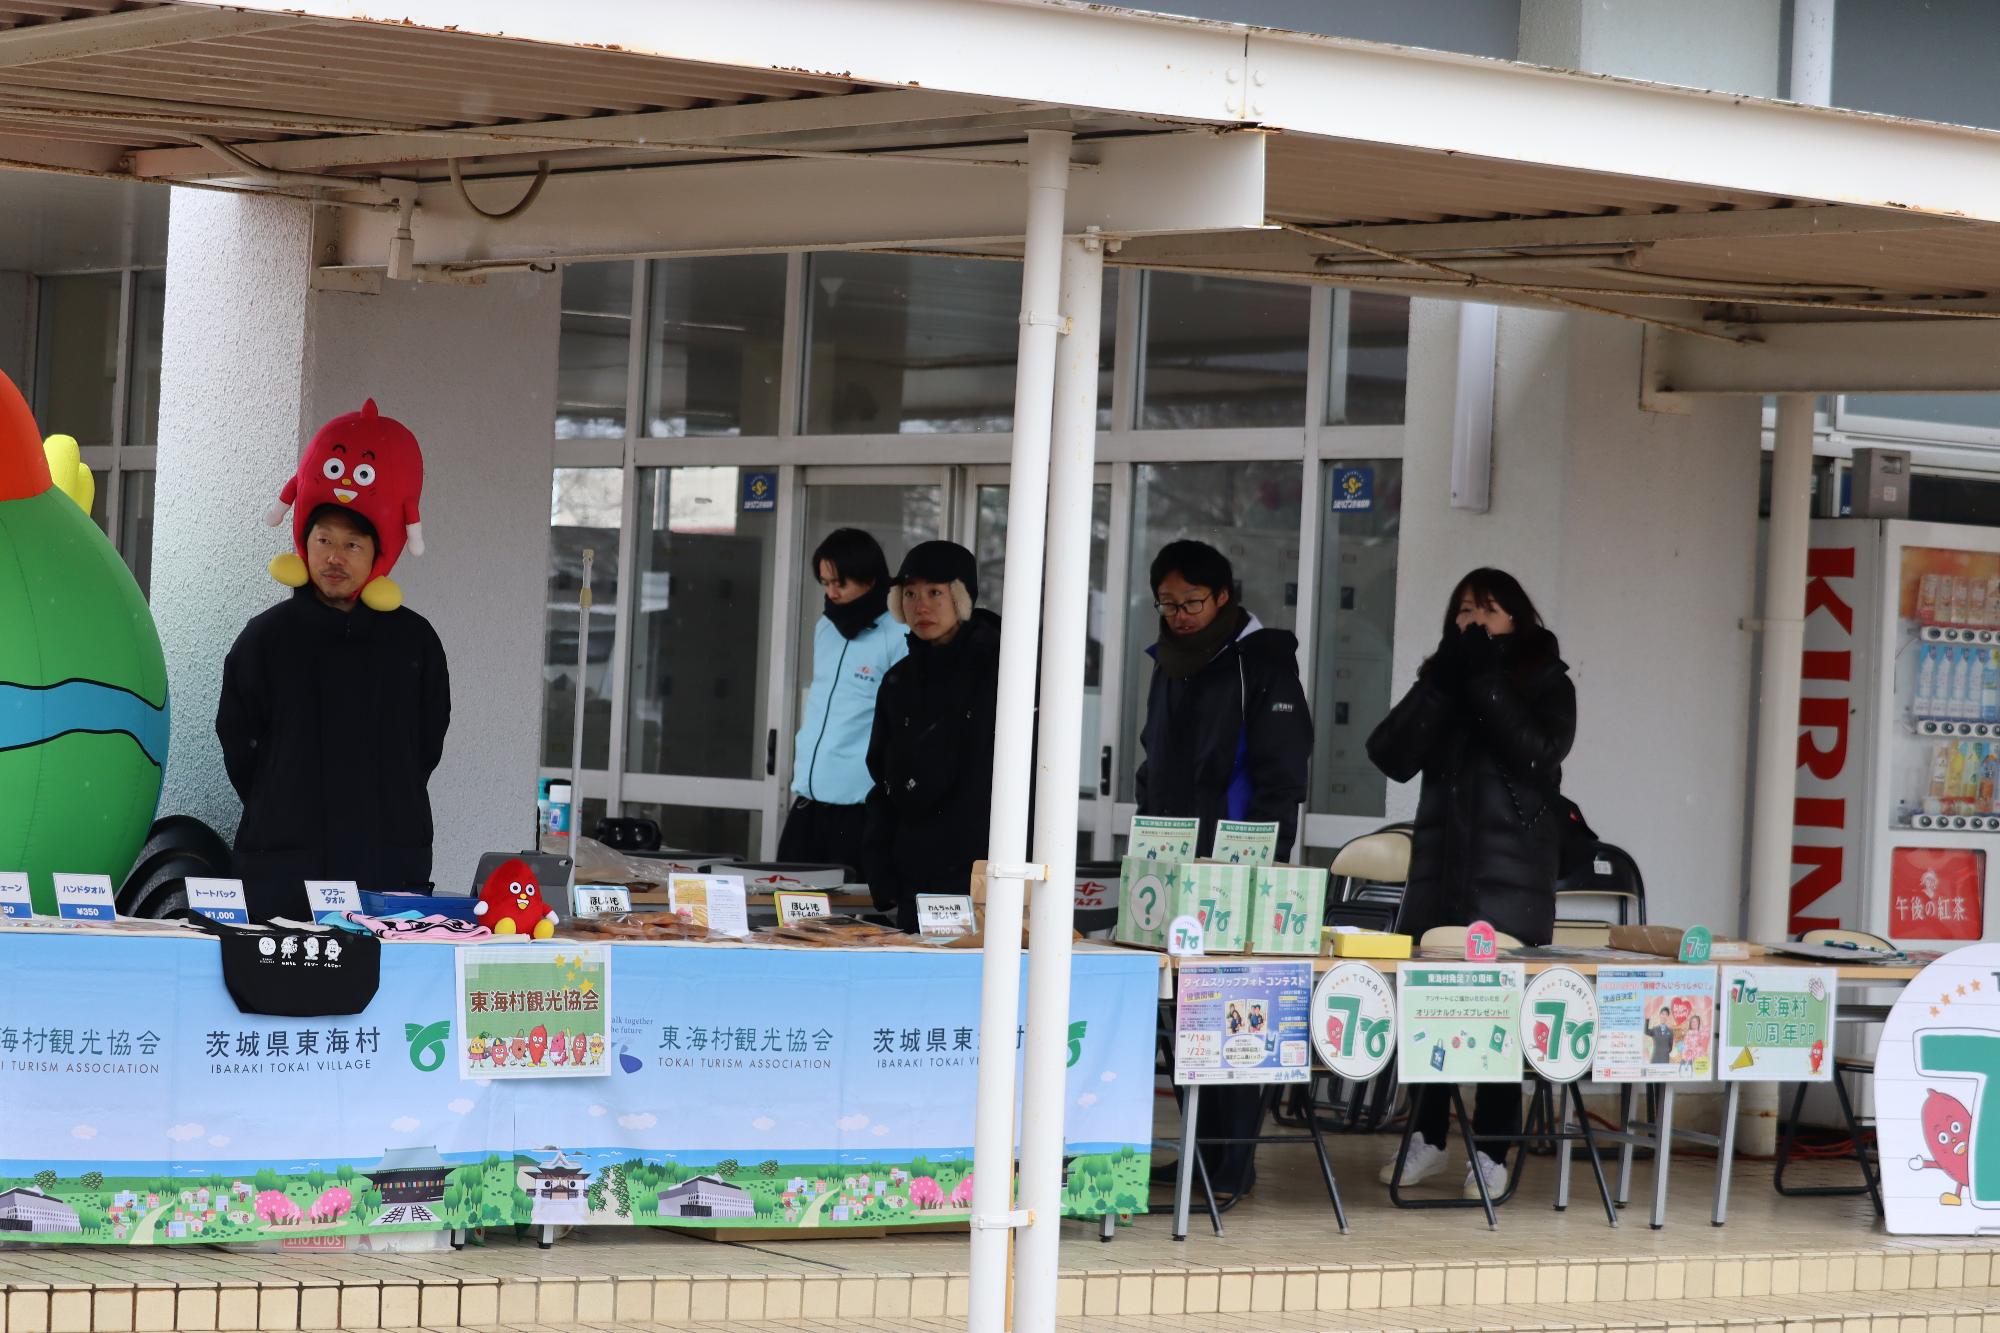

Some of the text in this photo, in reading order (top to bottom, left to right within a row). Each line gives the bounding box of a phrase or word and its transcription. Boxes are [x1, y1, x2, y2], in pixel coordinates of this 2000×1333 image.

[1787, 547, 1855, 935] KIRIN
[63, 885, 106, 894] ハンドタオル
[319, 888, 346, 896] マフラー
[325, 896, 346, 904] タオル
[791, 902, 821, 912] ほしいも
[2, 906, 15, 914] 50
[76, 907, 99, 916] ¥350
[1895, 896, 1968, 921] 午後の紅茶
[1353, 973, 1383, 996] TOKAI
[1558, 979, 1587, 1000] TOKAI
[469, 989, 600, 1013] 東海村観光協会
[1756, 996, 1808, 1018] 東海村
[659, 1025, 833, 1052] 東海村観光協会
[1746, 1023, 1816, 1044] 70周年PR
[206, 1026, 381, 1058] 茨城県東海村
[12, 1060, 59, 1072] TURISM
[66, 1062, 160, 1074] ASSOCIATION
[211, 1058, 372, 1074] IBARAKI TOKAI VILLAGE
[658, 1057, 832, 1069] TOKAI TURISM ASSOCIATION
[877, 1058, 923, 1069] IBARAKI
[929, 1056, 964, 1067] TOKAI
